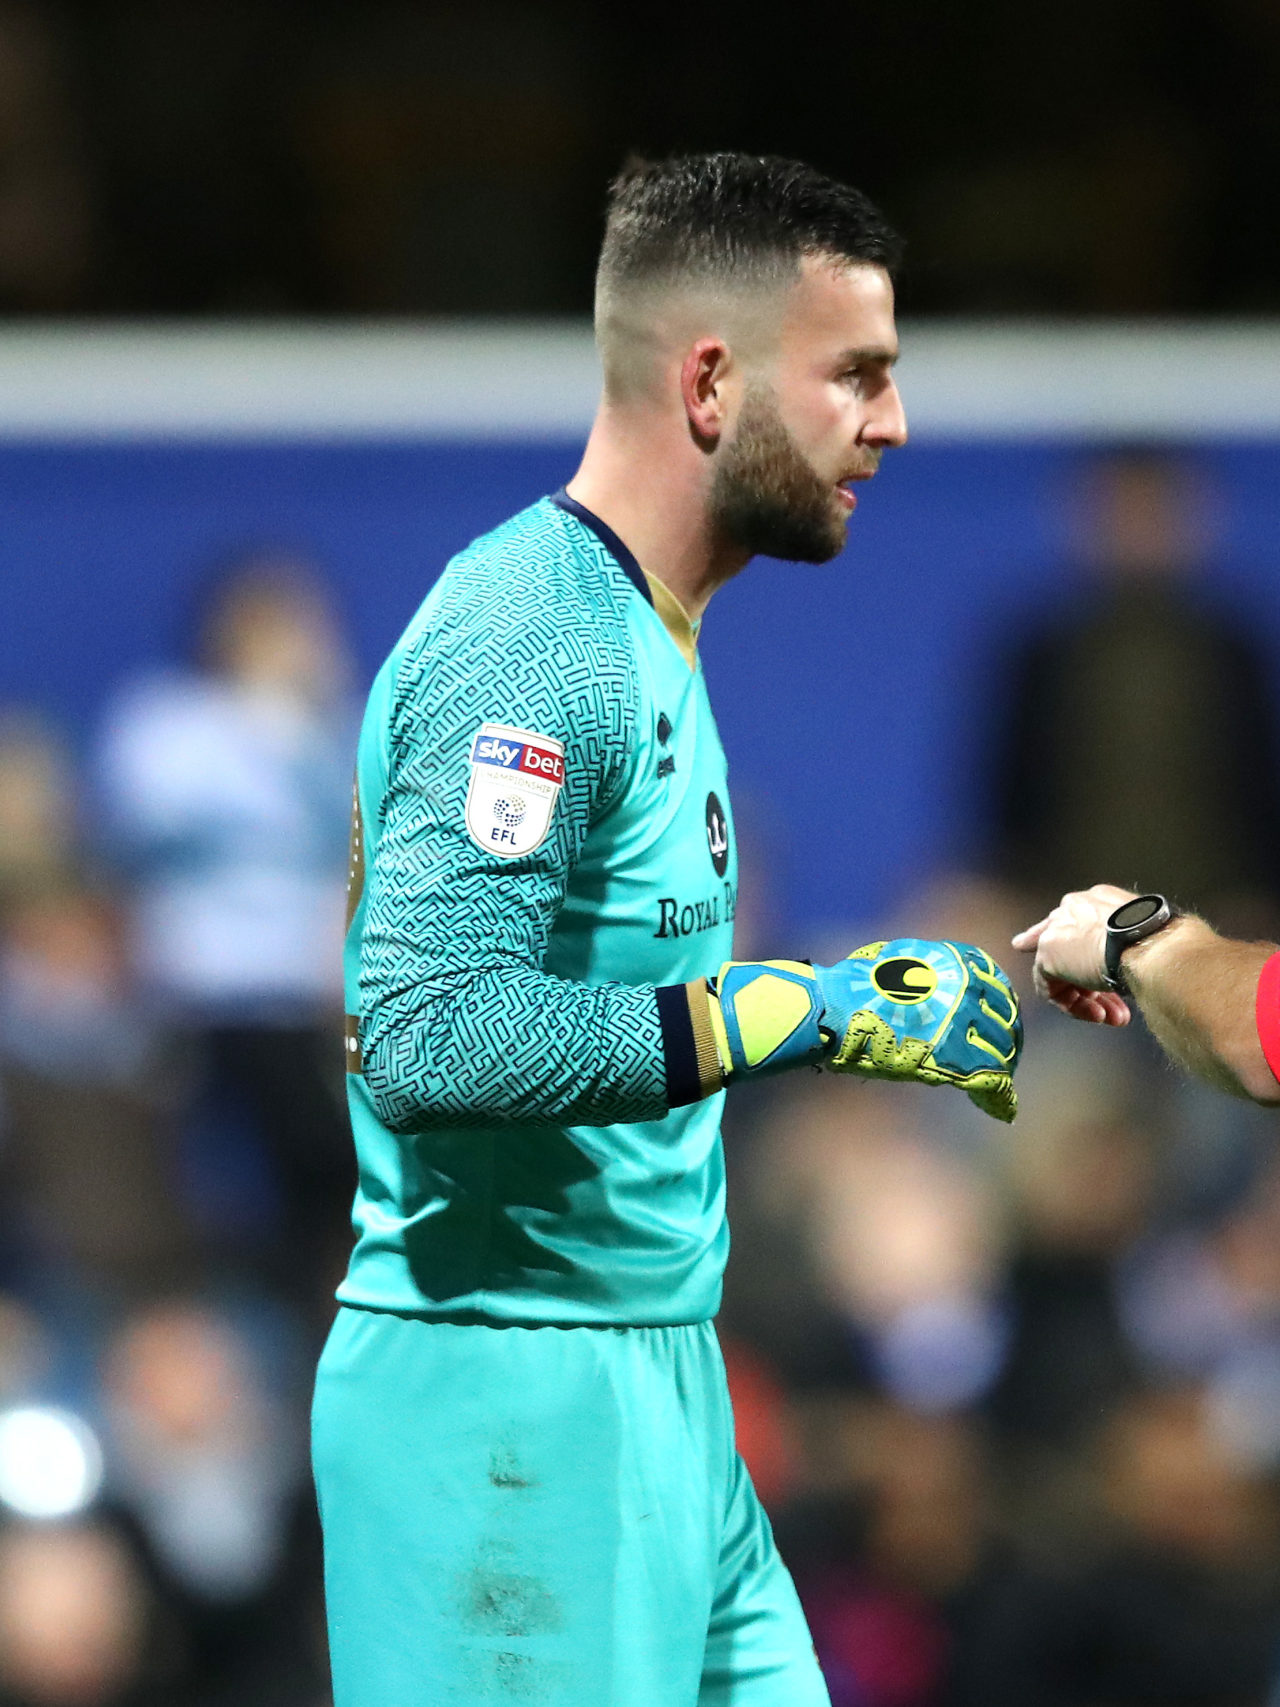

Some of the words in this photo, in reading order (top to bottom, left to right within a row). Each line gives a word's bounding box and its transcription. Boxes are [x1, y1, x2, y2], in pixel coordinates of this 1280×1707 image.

[478, 739, 520, 766] sky
[524, 747, 562, 777] bet
[491, 827, 517, 845] EFL
